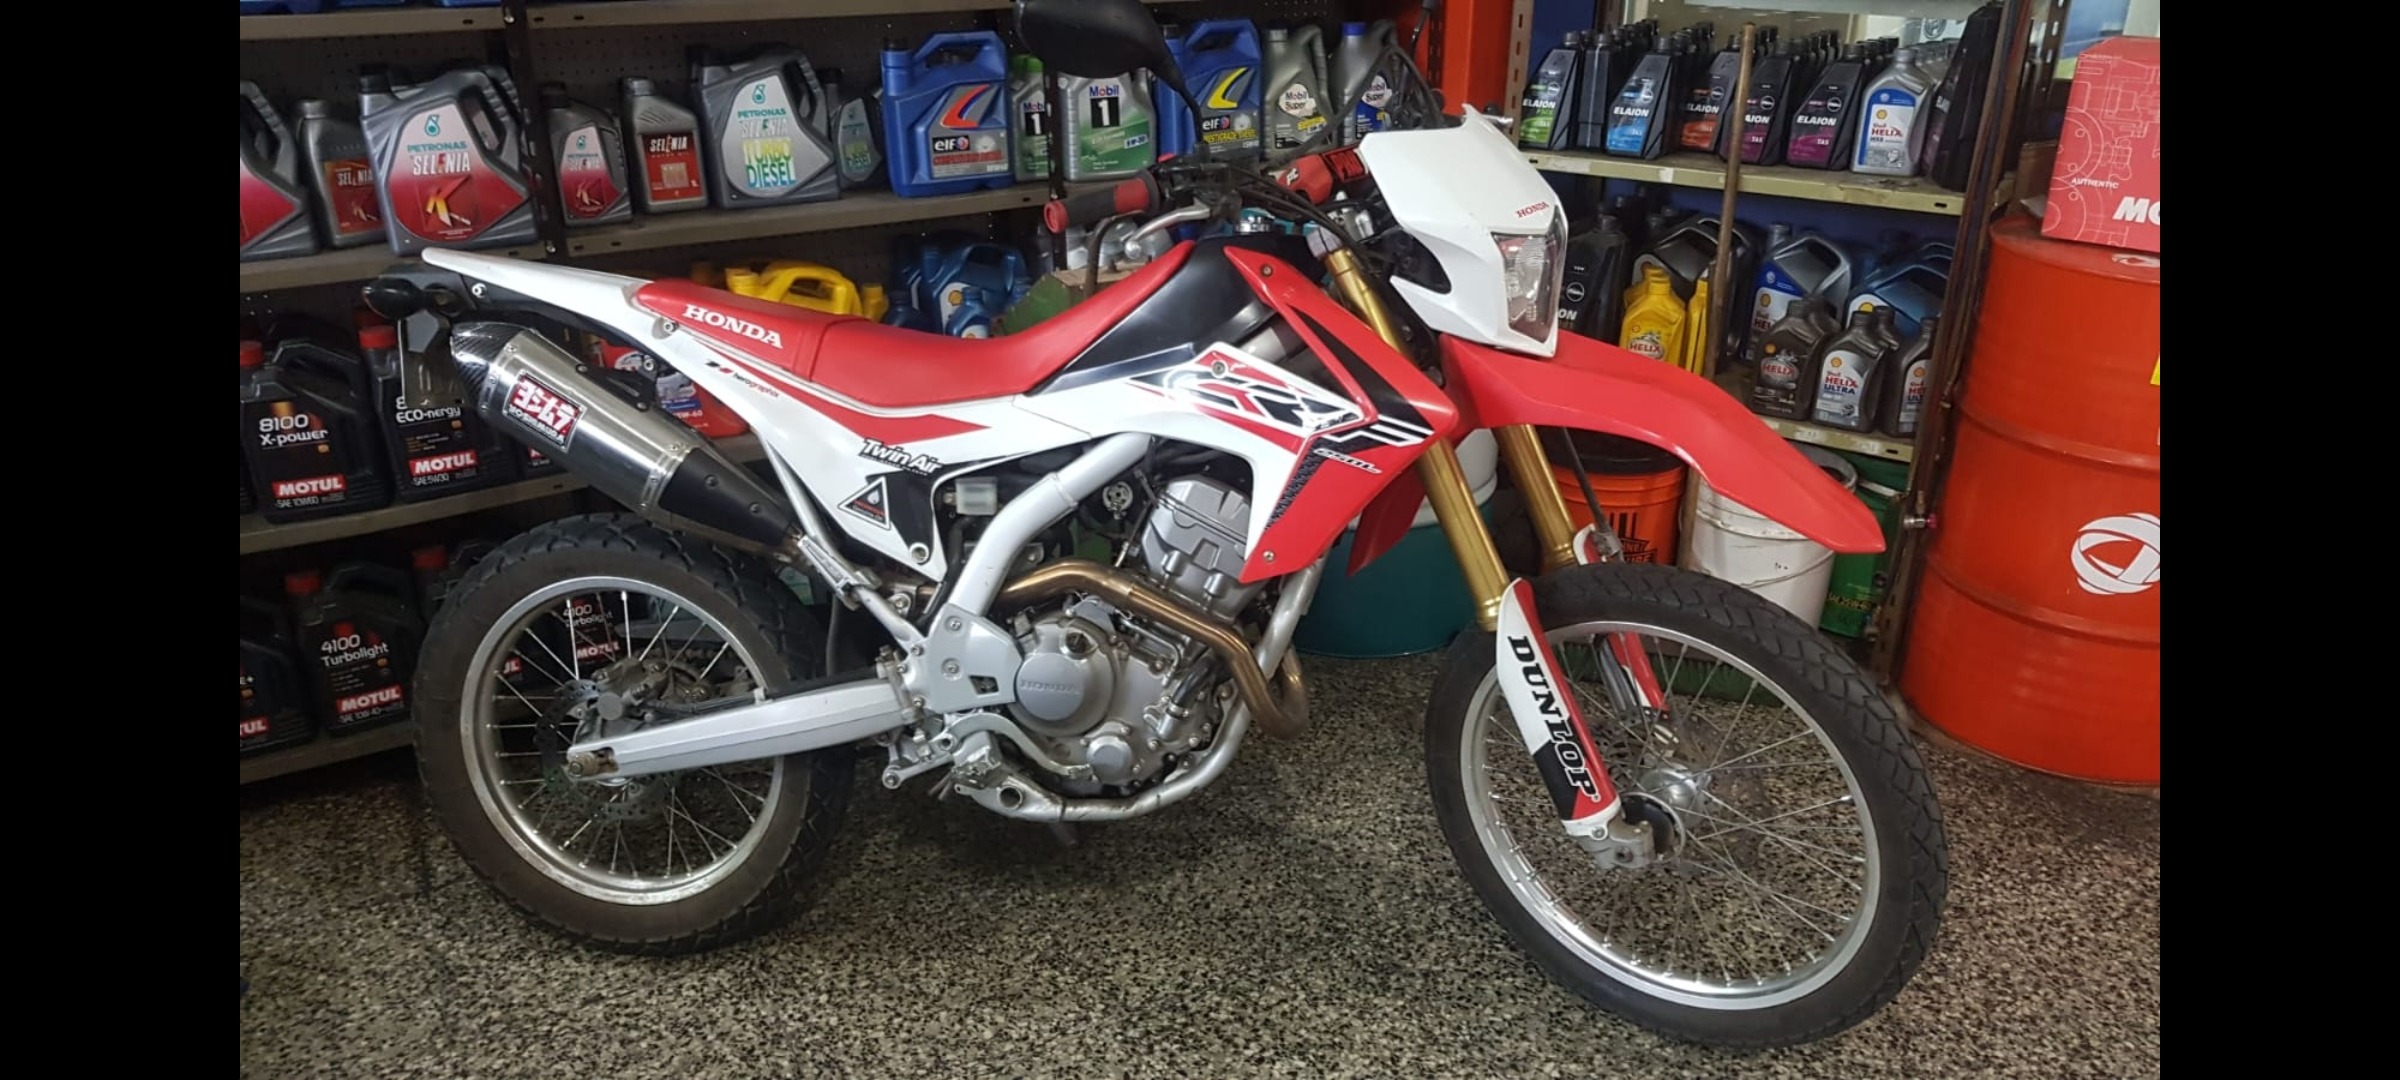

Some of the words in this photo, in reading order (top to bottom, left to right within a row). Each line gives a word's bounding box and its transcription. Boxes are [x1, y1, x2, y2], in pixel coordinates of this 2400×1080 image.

[1089, 85, 1119, 97] Mobil
[738, 107, 787, 118] PETRONAS
[1523, 98, 1556, 109] ELAION
[1613, 106, 1650, 118] ELAION
[1099, 99, 1111, 127] 1
[1796, 114, 1837, 126] ELAION
[1202, 118, 1220, 131] elf
[1871, 127, 1904, 138] HELIX
[407, 141, 468, 153] PETRONAS
[650, 135, 688, 153] SELENIA
[934, 138, 957, 151] elf
[413, 152, 471, 176] SELENIA
[745, 161, 797, 189] DIESEL
[2071, 176, 2120, 190] AUTHENTIC
[1515, 200, 1550, 218] HONDA
[681, 304, 784, 349] HONDA
[1628, 341, 1662, 353] HELIX
[1761, 363, 1797, 376] HELIX
[1823, 384, 1856, 395] ULTRA
[1824, 376, 1859, 389] HELIX
[513, 379, 577, 431] ヨシムラ
[259, 413, 309, 433] 8100
[395, 406, 461, 424] ECO-nergy
[259, 429, 329, 448] X-power
[414, 453, 476, 474] MOTUL
[859, 437, 912, 467] Twin
[907, 453, 943, 475] Air
[278, 476, 343, 497] MOTUL
[321, 633, 361, 654] 4100
[320, 642, 390, 667] Turbolight
[340, 686, 401, 713] MOTUL
[1507, 635, 1600, 799] DUNLOP
